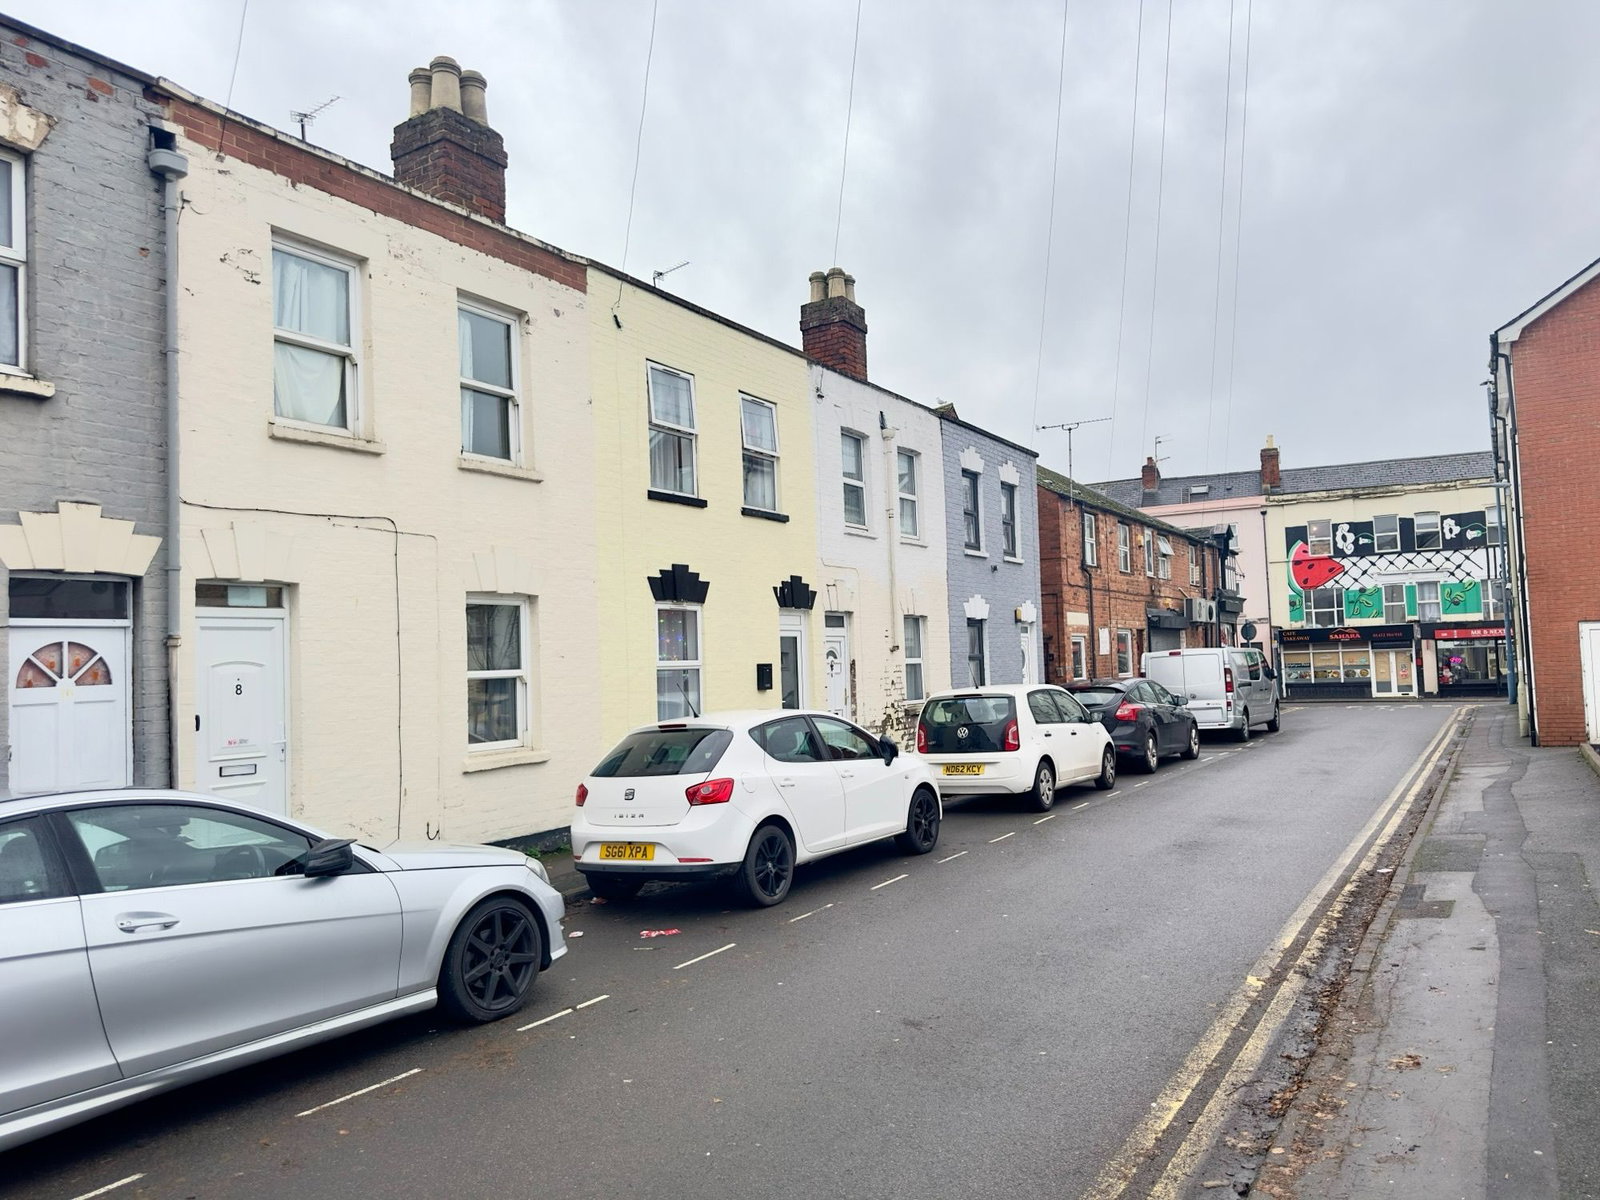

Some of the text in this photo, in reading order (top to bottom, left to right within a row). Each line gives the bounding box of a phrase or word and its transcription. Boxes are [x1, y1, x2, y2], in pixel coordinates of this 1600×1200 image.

[235, 684, 242, 695] 8
[966, 765, 982, 773] KCY
[604, 845, 648, 859] SG61 XPA
